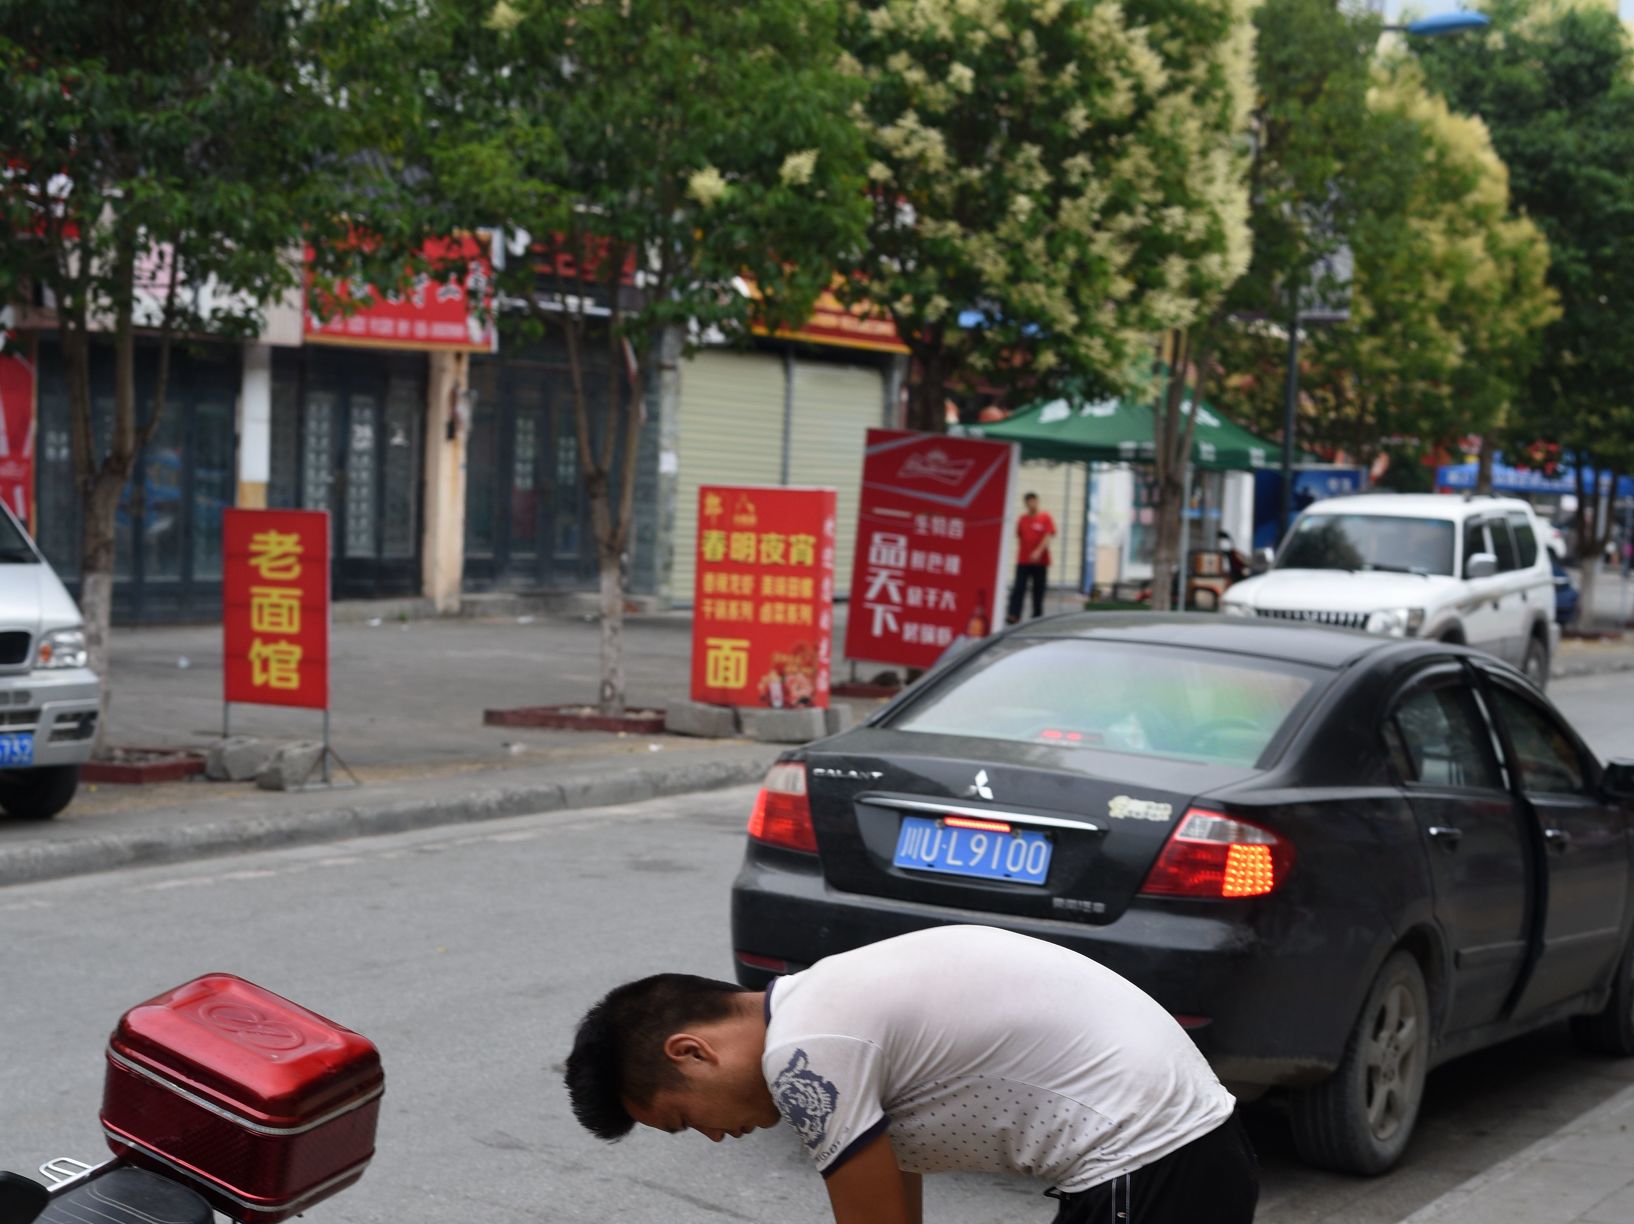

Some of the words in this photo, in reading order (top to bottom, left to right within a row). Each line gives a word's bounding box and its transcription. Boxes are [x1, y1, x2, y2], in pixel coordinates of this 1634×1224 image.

[703, 530, 816, 567] 春明夜宵
[248, 529, 304, 690] 老面馆
[705, 637, 750, 689] 面
